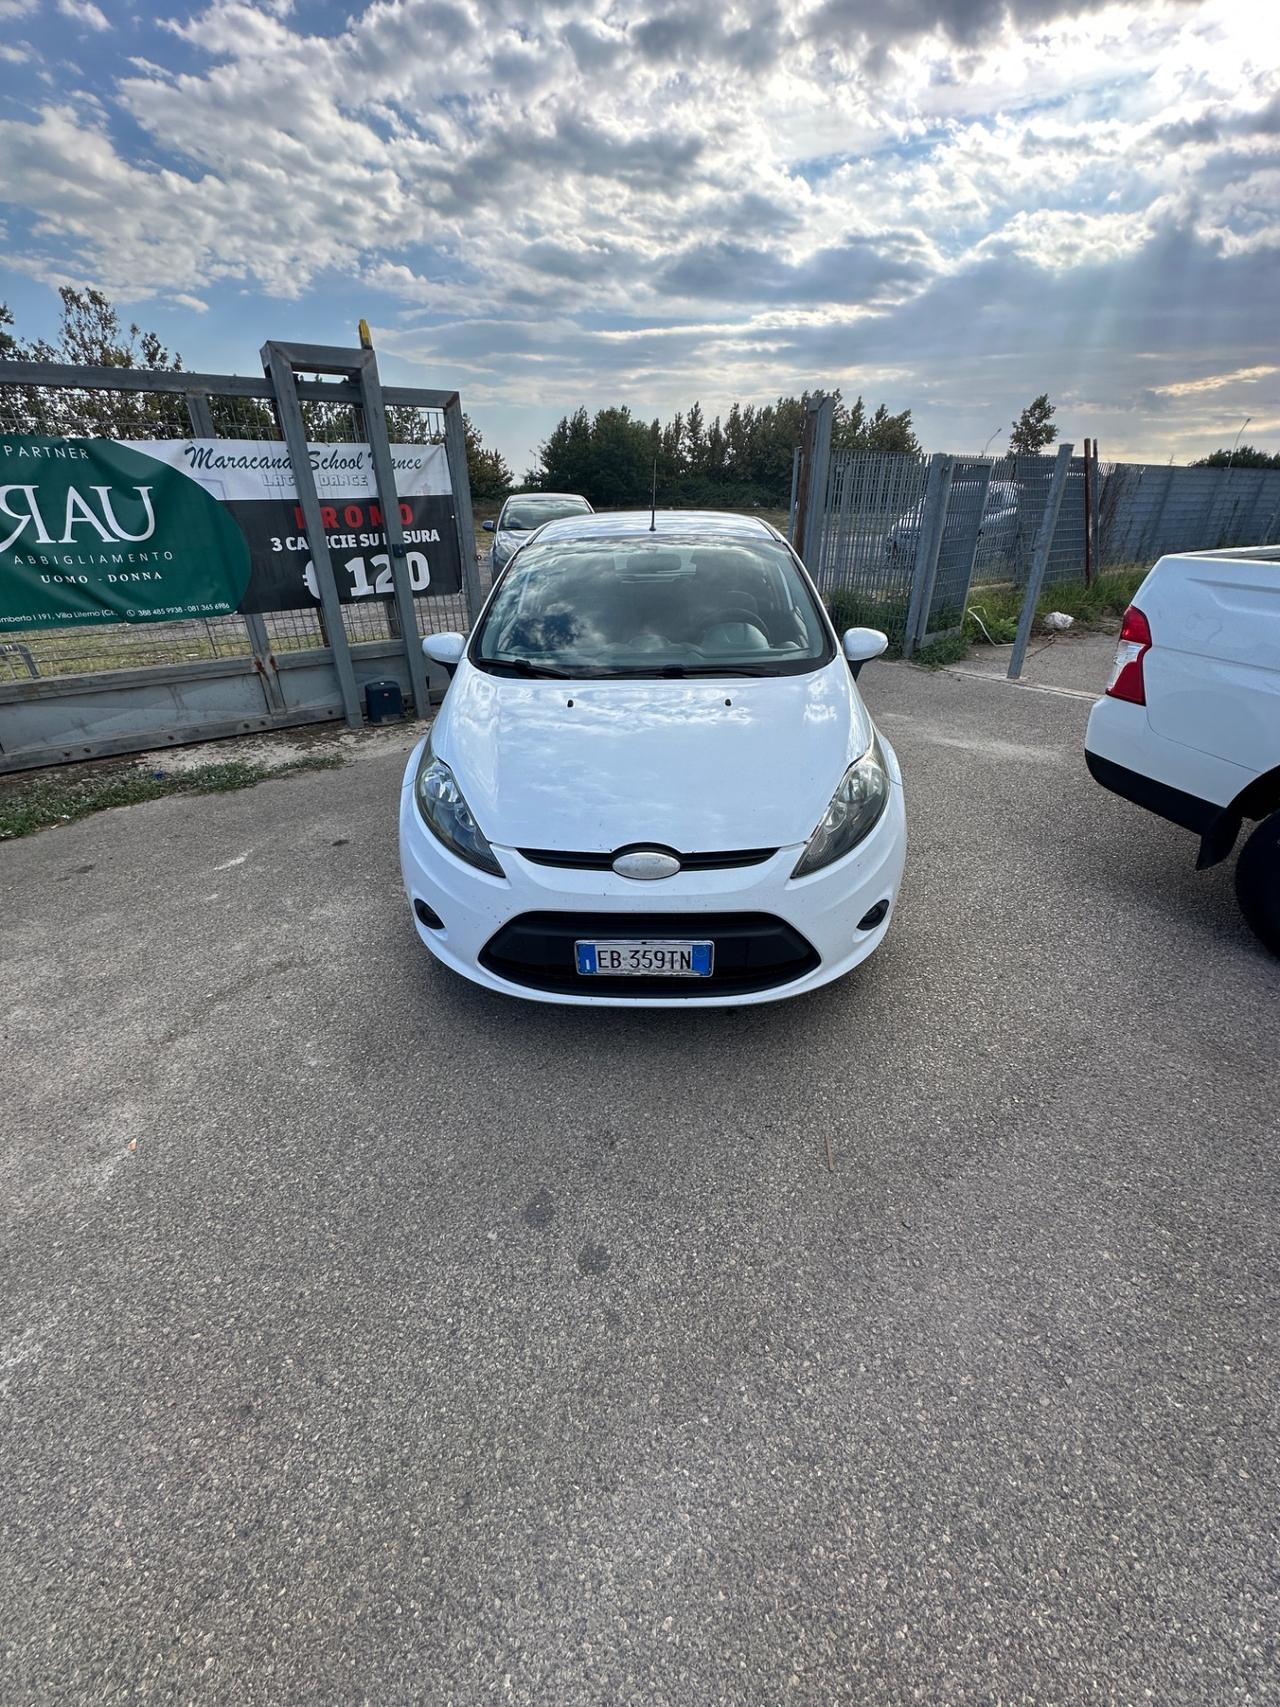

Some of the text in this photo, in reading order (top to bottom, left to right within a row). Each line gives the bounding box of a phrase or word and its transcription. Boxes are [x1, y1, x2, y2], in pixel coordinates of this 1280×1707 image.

[3, 445, 89, 459] PARTNER
[308, 449, 364, 470] School
[319, 474, 369, 487] DANCE
[270, 529, 441, 552] 3 CAICIE SU SURA
[14, 551, 174, 565] ABBIGLIAMENTO
[40, 574, 89, 584] UOMO
[108, 571, 163, 583] DONNA
[344, 551, 431, 597] 120
[0, 614, 32, 623] mberto
[55, 611, 73, 619] Villa
[597, 950, 622, 969] EB
[628, 949, 691, 970] 359TN
